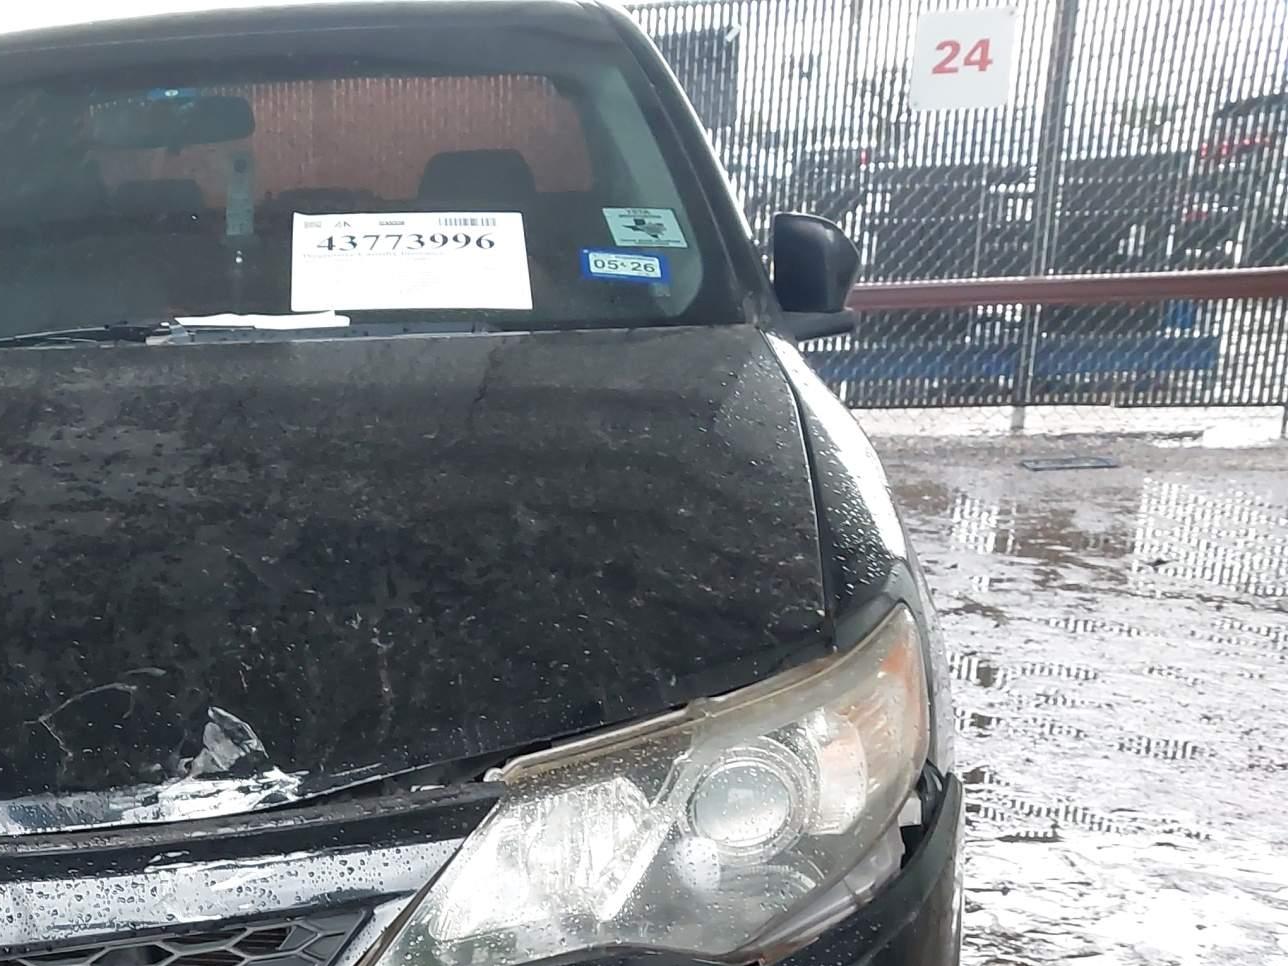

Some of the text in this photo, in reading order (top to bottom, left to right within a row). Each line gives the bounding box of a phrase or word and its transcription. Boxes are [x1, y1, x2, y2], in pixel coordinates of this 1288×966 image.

[932, 38, 994, 74] 24
[317, 233, 495, 251] 43773996
[593, 259, 656, 273] 05 26
